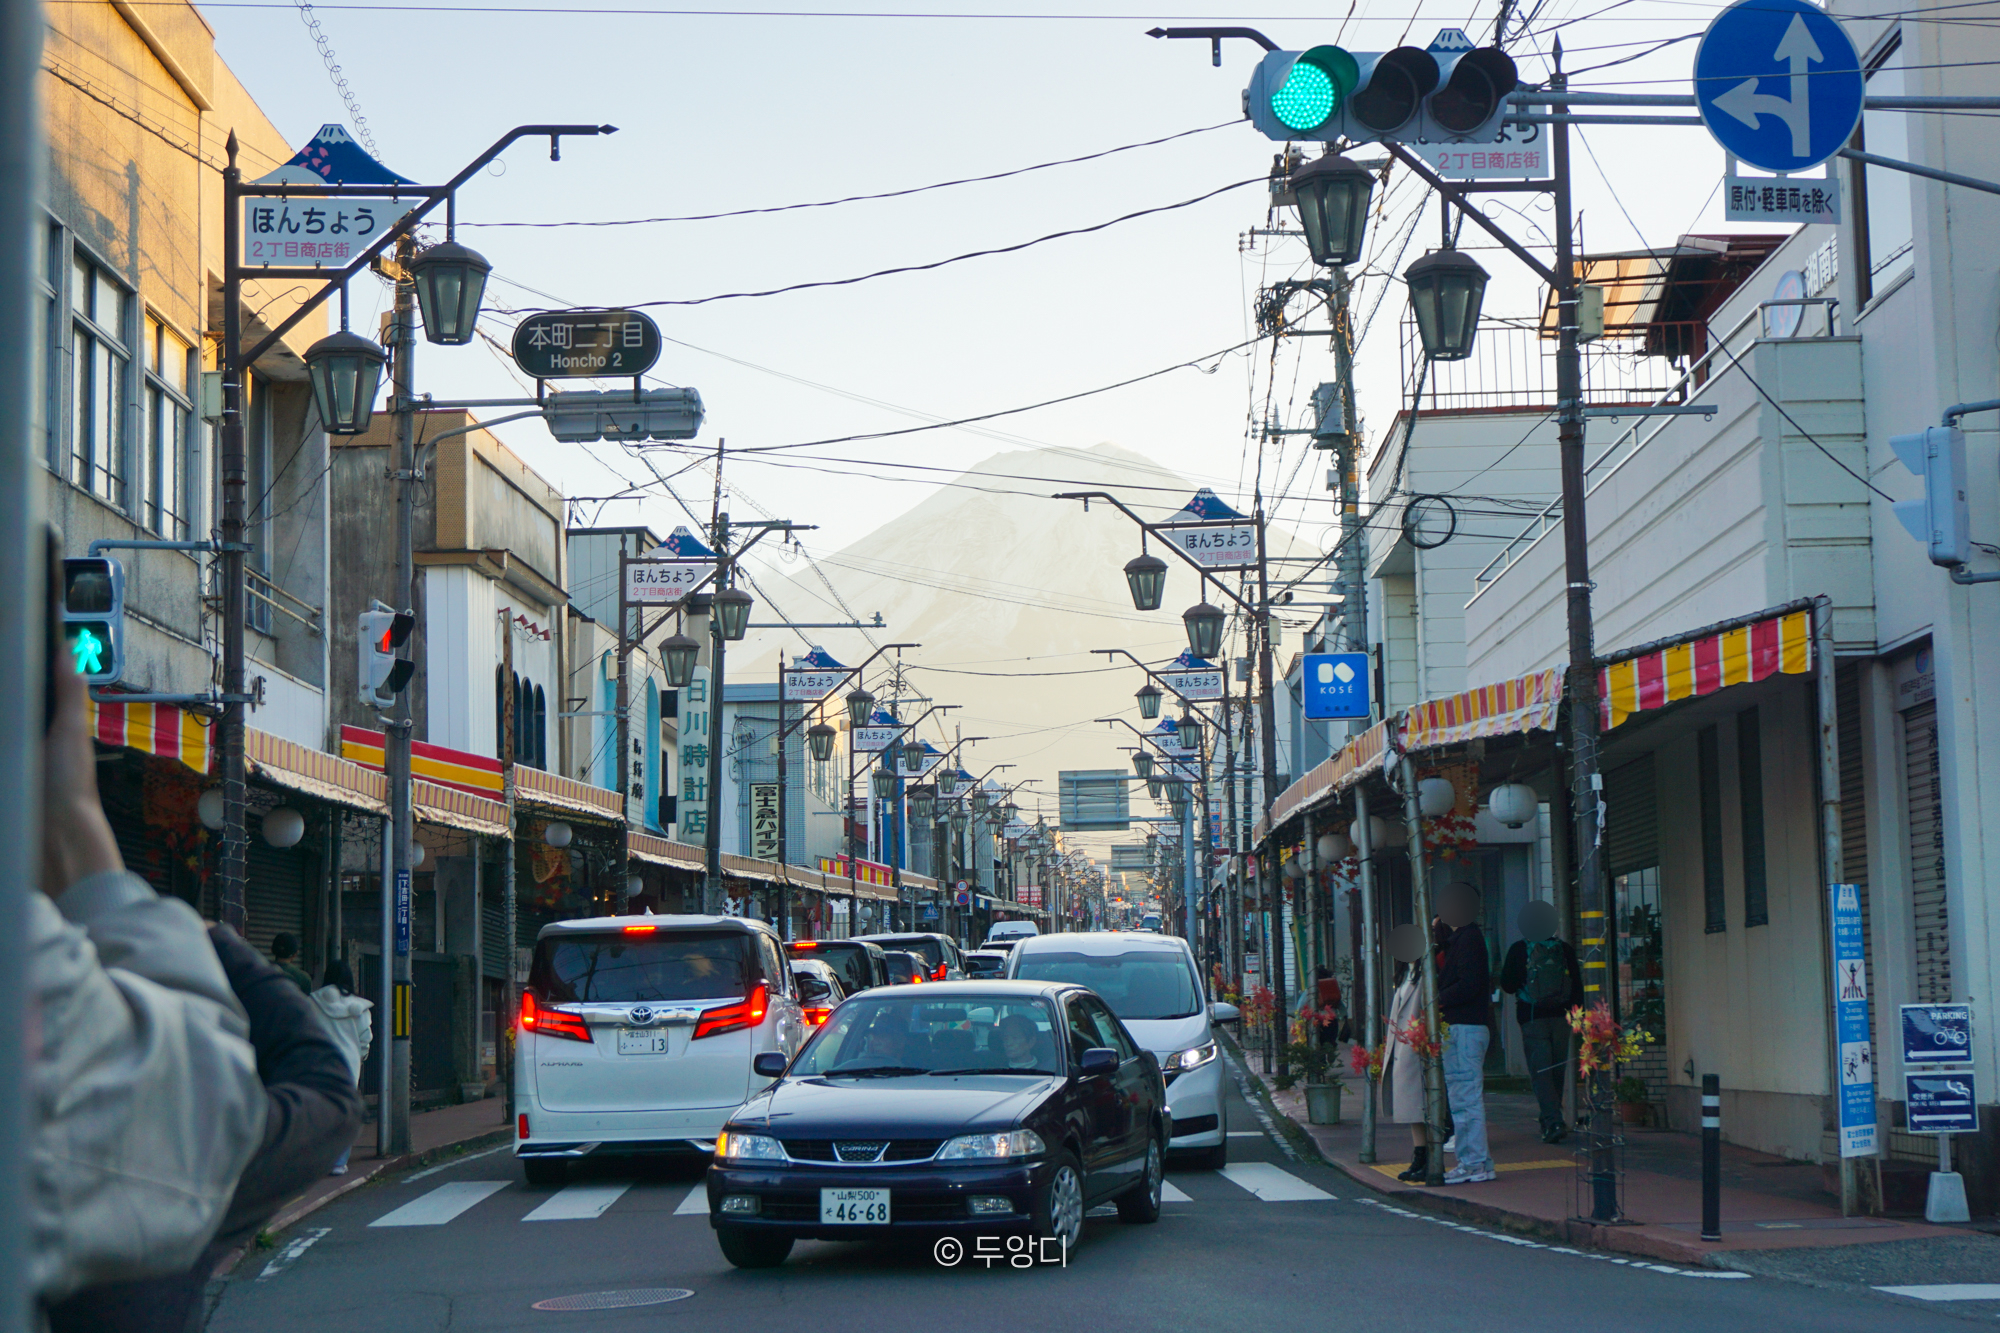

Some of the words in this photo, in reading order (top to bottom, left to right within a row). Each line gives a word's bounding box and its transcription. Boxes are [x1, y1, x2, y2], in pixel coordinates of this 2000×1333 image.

[1438, 151, 1540, 170] 2丁目商店街
[1731, 185, 1834, 214] 原付・軽車両を除く
[253, 206, 375, 236] ほんちょう
[252, 241, 350, 258] 2丁目商店街
[528, 321, 643, 351] 本町二丁目
[550, 353, 607, 369] Honcho
[612, 352, 623, 367] 2
[1185, 530, 1252, 549] ほんちょう
[1198, 550, 1252, 562] 2丁目商店街
[633, 568, 696, 584] ほんちょう
[633, 587, 683, 597] 2丁目商店街
[788, 676, 834, 687] ほんちょう
[1175, 675, 1220, 688] ほんちょう
[1320, 684, 1354, 695] KOSÉ
[857, 730, 893, 740] ほんちょう
[1931, 1011, 1968, 1021] PARKING
[836, 1203, 887, 1222] 46-68
